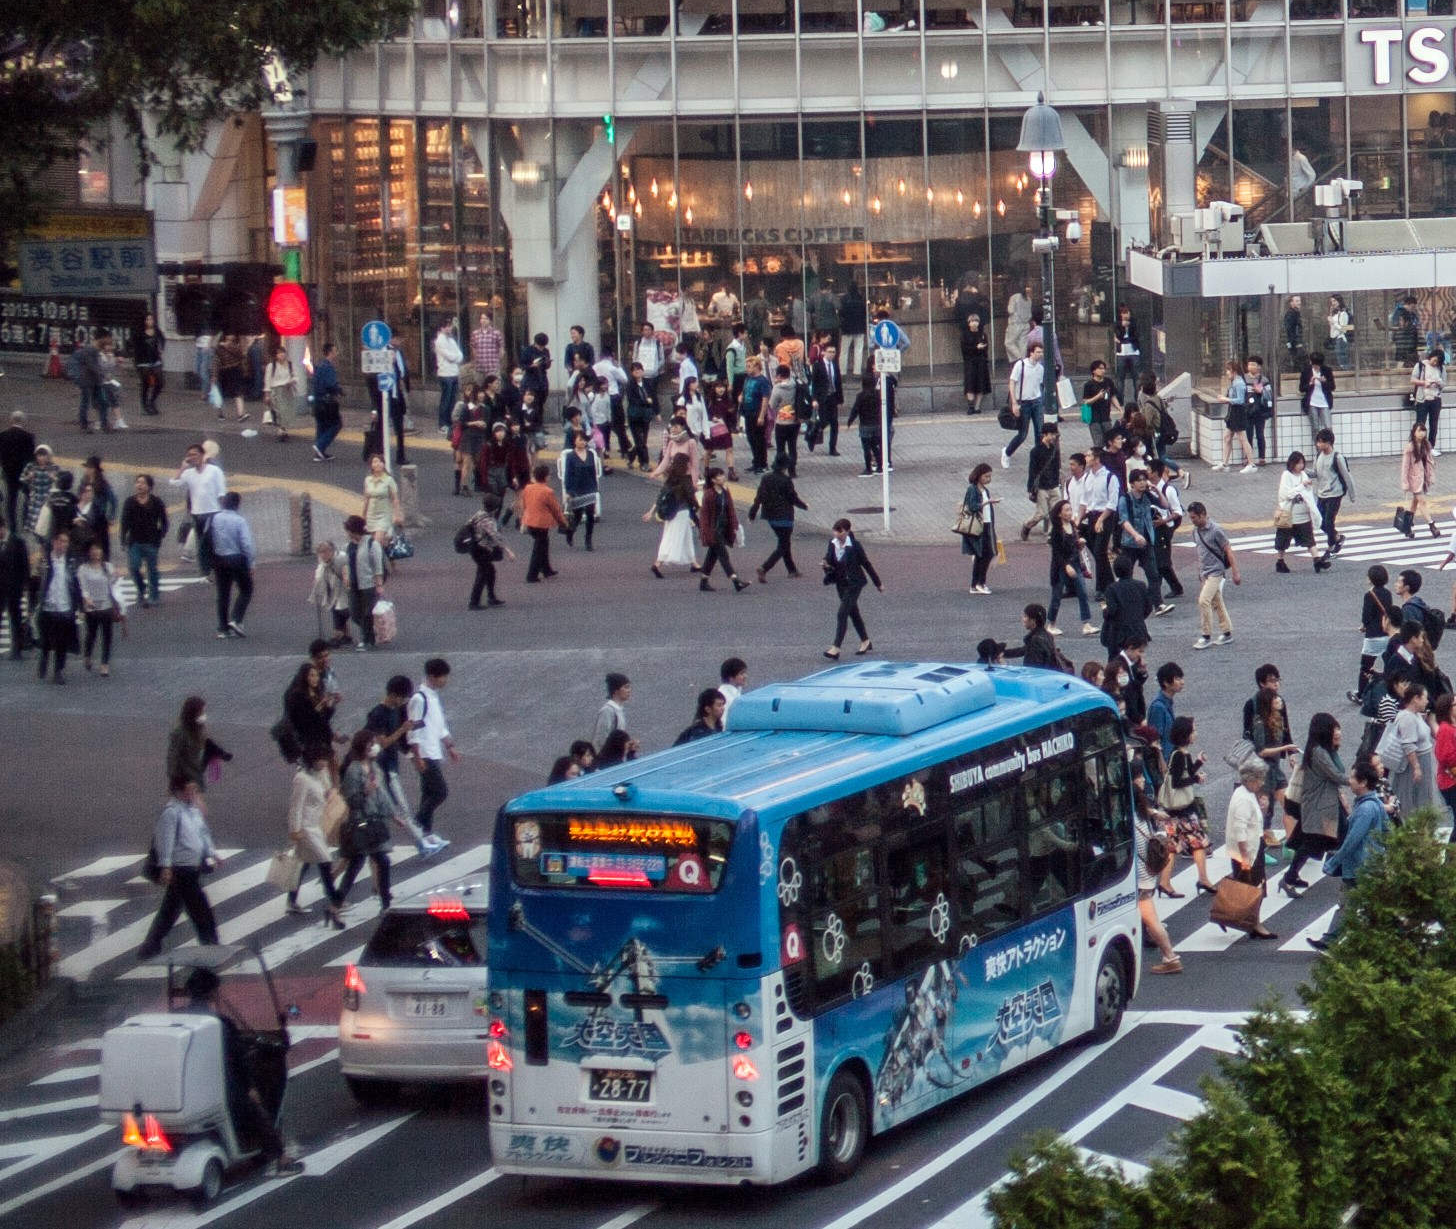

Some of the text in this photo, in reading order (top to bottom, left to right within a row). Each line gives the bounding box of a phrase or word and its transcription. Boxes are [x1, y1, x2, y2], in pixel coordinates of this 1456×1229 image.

[676, 226, 864, 243] TARBUCKS COFFEE
[28, 245, 146, 273] 渋谷駅前
[950, 732, 1074, 793] SHIBUYA community bus HACHIKO
[679, 859, 700, 885] Q
[786, 932, 799, 958] Q
[985, 928, 1067, 983] 爽快アトラクション
[600, 1078, 649, 1100] 28-77
[509, 1134, 570, 1161] 爽快
